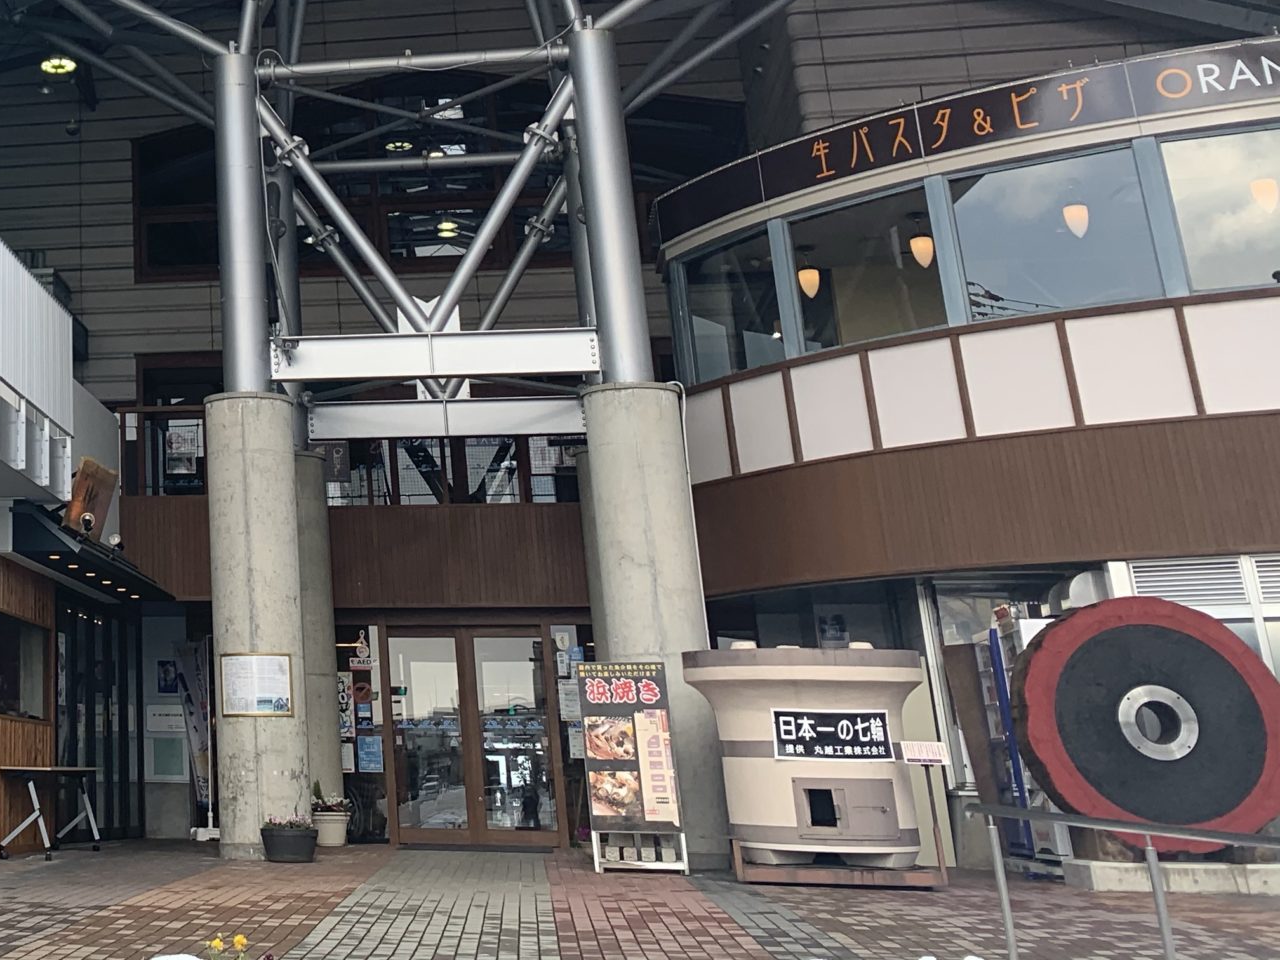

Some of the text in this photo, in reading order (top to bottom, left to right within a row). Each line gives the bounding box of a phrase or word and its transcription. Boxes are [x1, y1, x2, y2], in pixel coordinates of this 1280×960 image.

[585, 678, 661, 704] 浜焼き
[779, 715, 885, 743] 日本一の七輪
[785, 743, 806, 754] 提供
